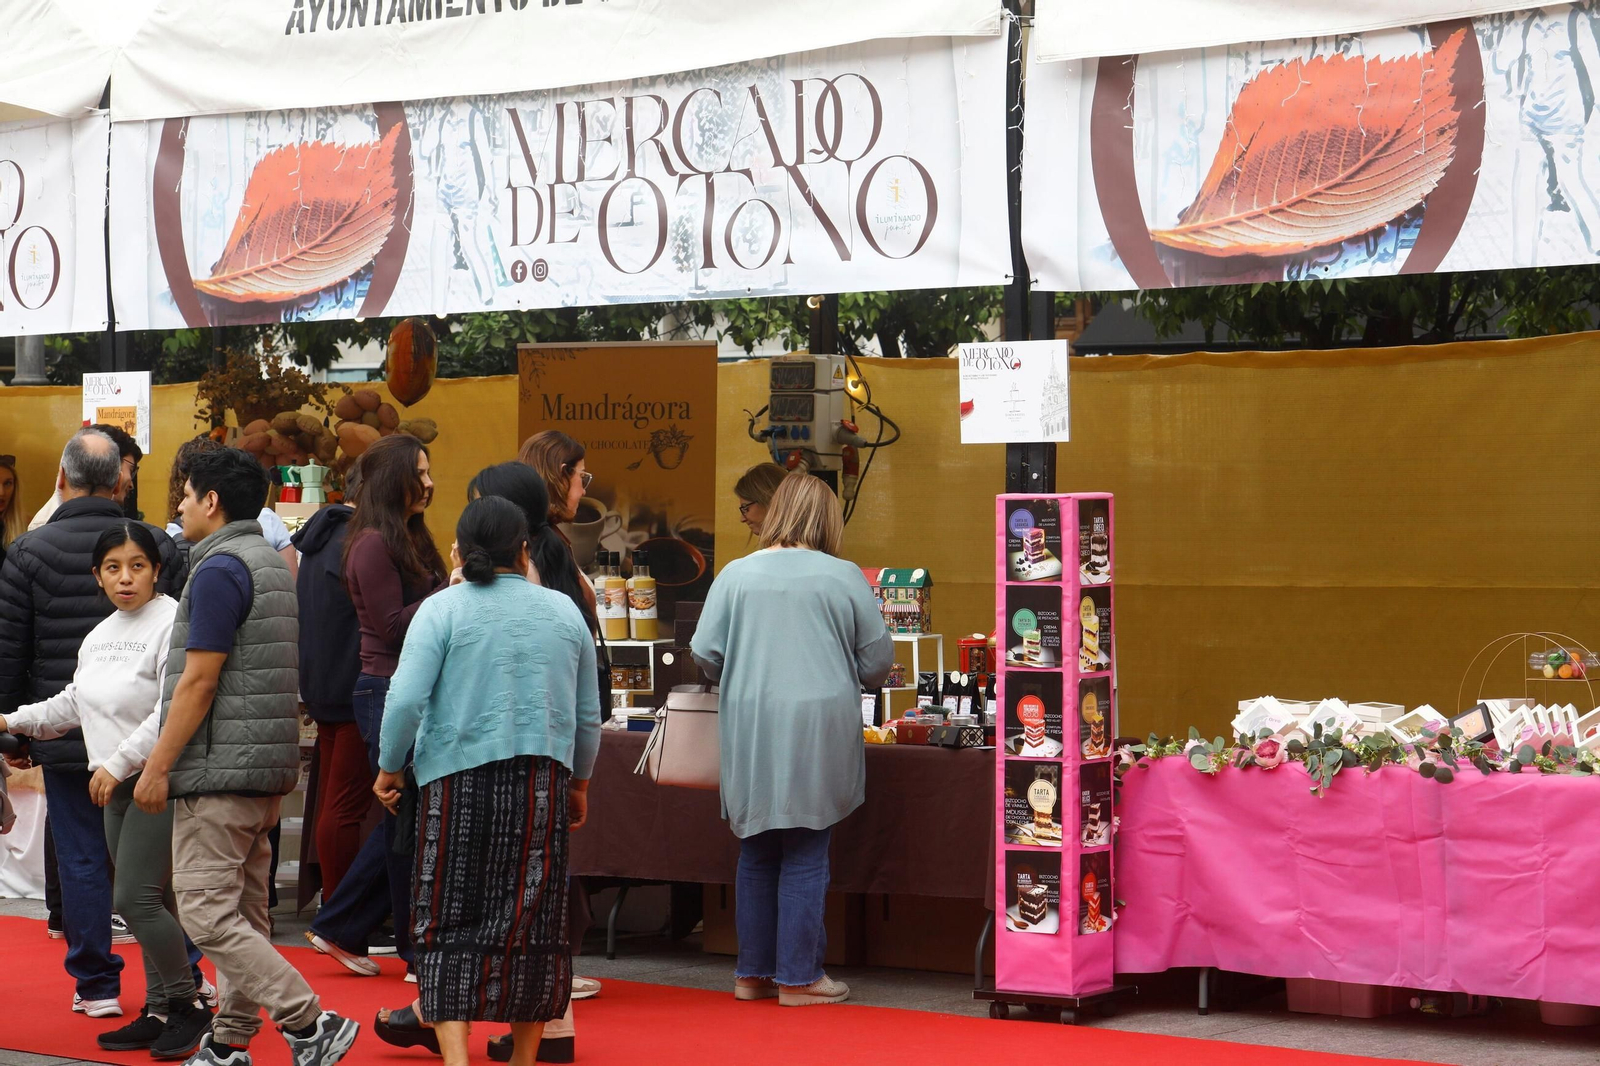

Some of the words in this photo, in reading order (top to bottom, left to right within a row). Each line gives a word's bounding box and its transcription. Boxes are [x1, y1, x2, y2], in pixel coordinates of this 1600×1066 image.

[285, 0, 531, 35] AYUNTAMI
[507, 73, 883, 187] MERCADO
[505, 183, 582, 247] DE
[963, 347, 1014, 359] MERCADO
[541, 393, 693, 430] Mandrágora
[1093, 523, 1105, 532] OREO
[1034, 788, 1050, 796] TARTA
[302, 1051, 314, 1062] FILA
